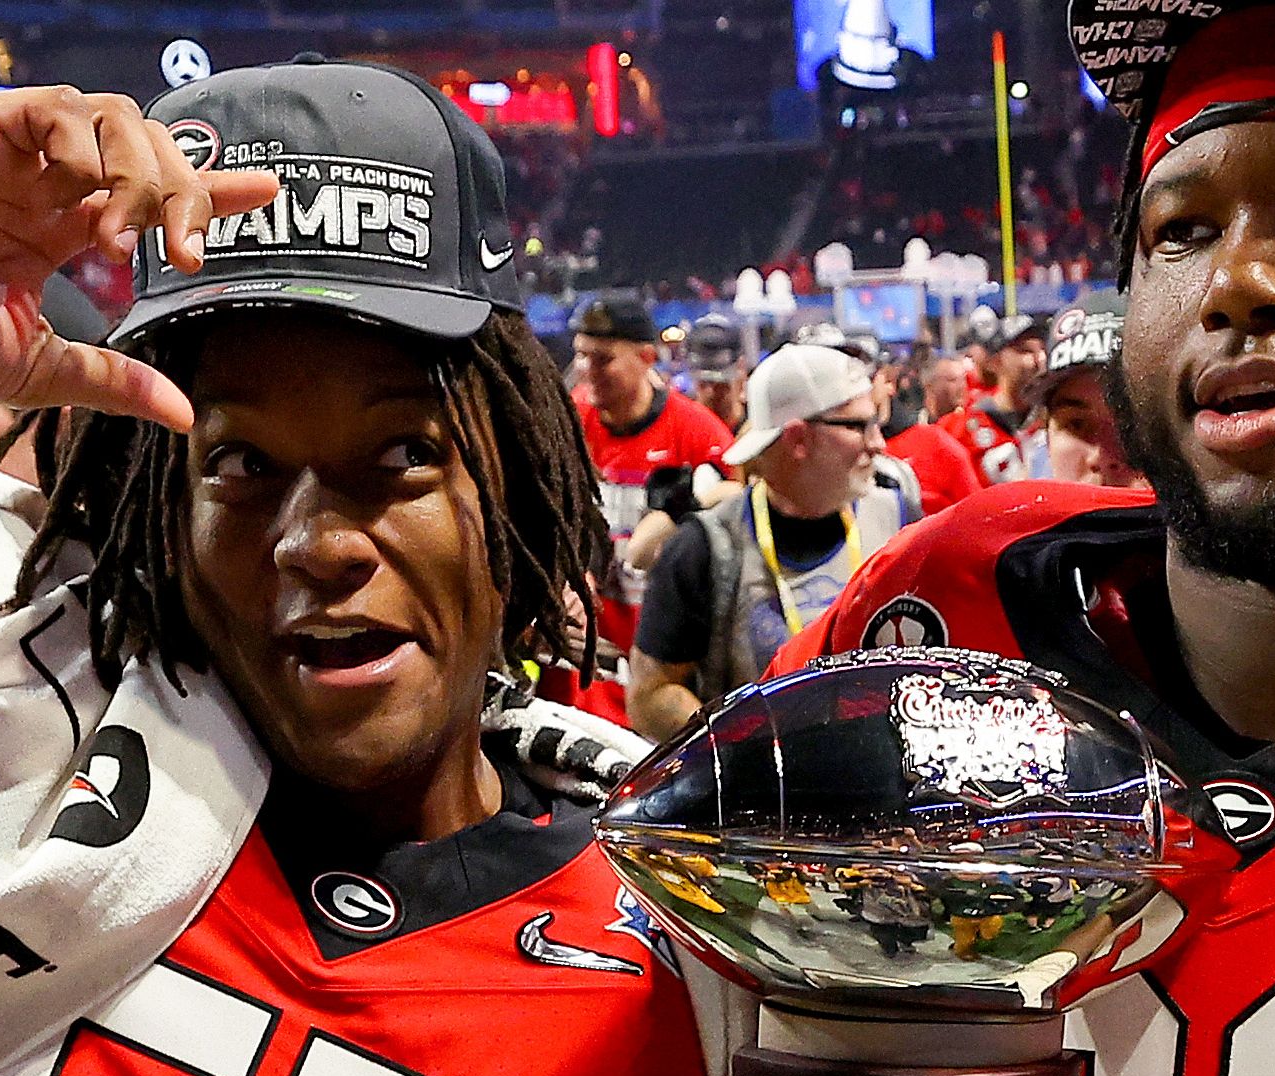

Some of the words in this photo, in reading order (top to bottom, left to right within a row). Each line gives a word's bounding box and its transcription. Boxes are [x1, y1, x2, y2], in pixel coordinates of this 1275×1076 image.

[1079, 46, 1178, 70] HAMPS
[329, 165, 387, 189] PEACH
[388, 173, 435, 197] BOWL
